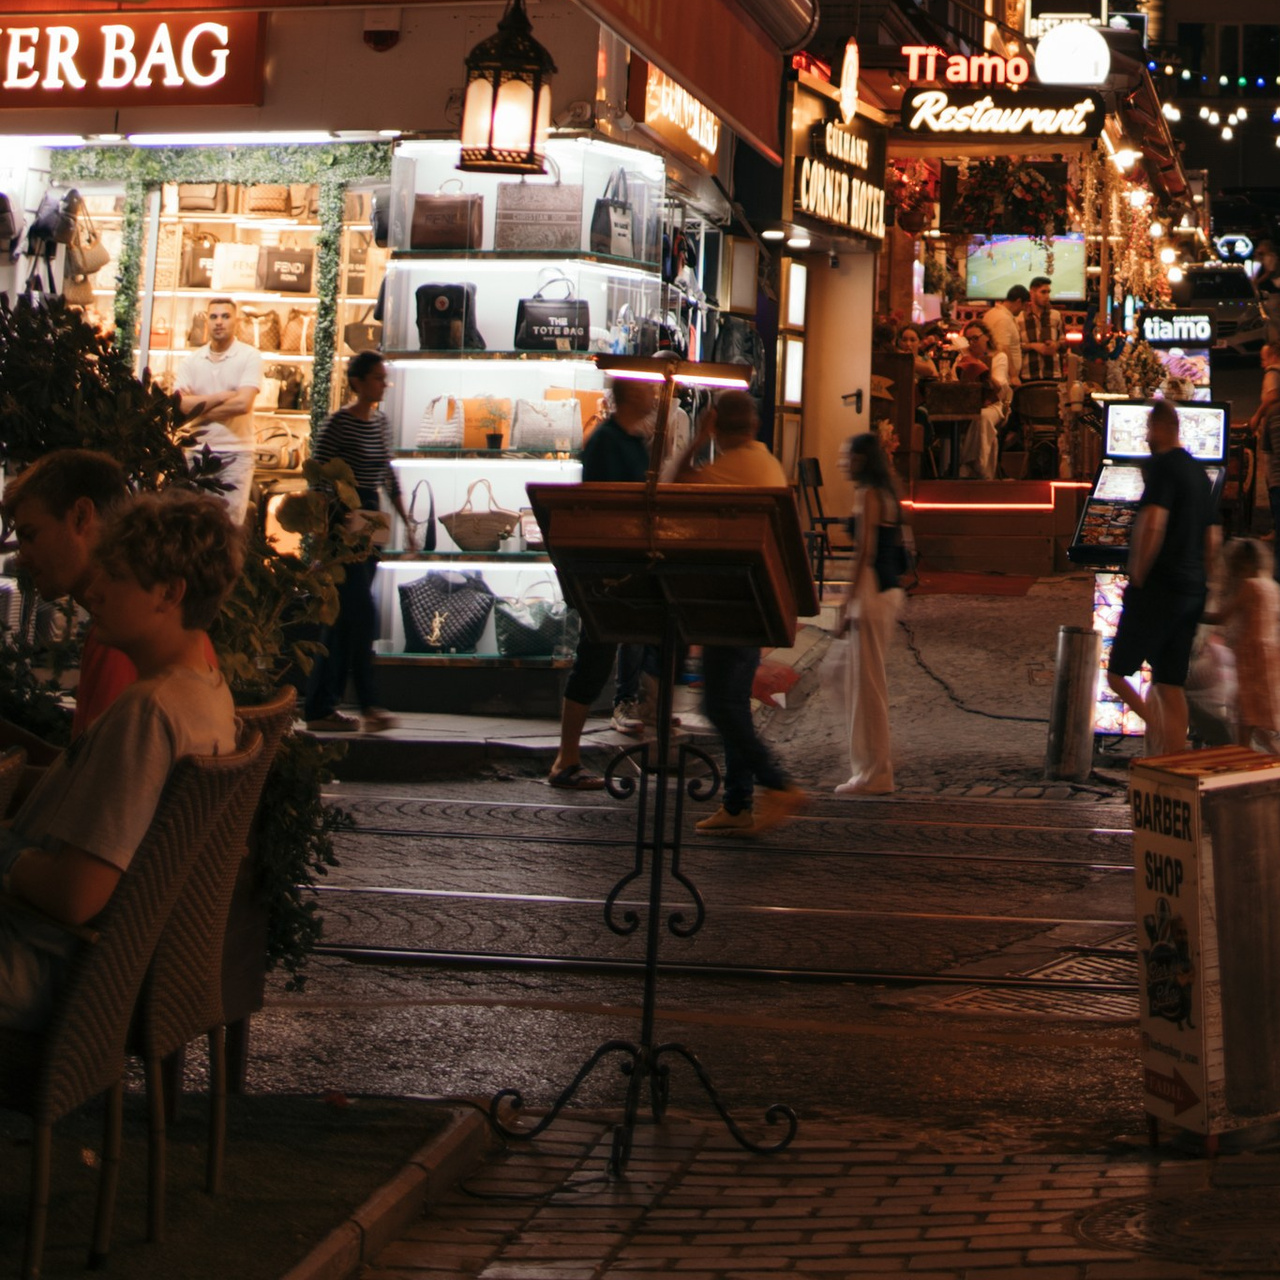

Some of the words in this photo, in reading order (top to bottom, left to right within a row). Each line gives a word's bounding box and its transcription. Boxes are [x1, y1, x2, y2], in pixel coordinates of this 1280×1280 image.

[0, 25, 87, 89] ER
[97, 22, 230, 87] BAG
[910, 90, 1095, 135] Restaurant
[801, 157, 849, 225] CORNER
[850, 178, 886, 239] HOTEL
[512, 213, 548, 221] CHRISTIAN
[274, 261, 305, 274] FENDI
[532, 326, 561, 336] TOTE
[563, 326, 585, 336] BAG
[548, 316, 568, 326] THE
[1143, 316, 1211, 340] tiamo
[1132, 789, 1192, 841] BARBER
[1144, 850, 1183, 898] SHOP
